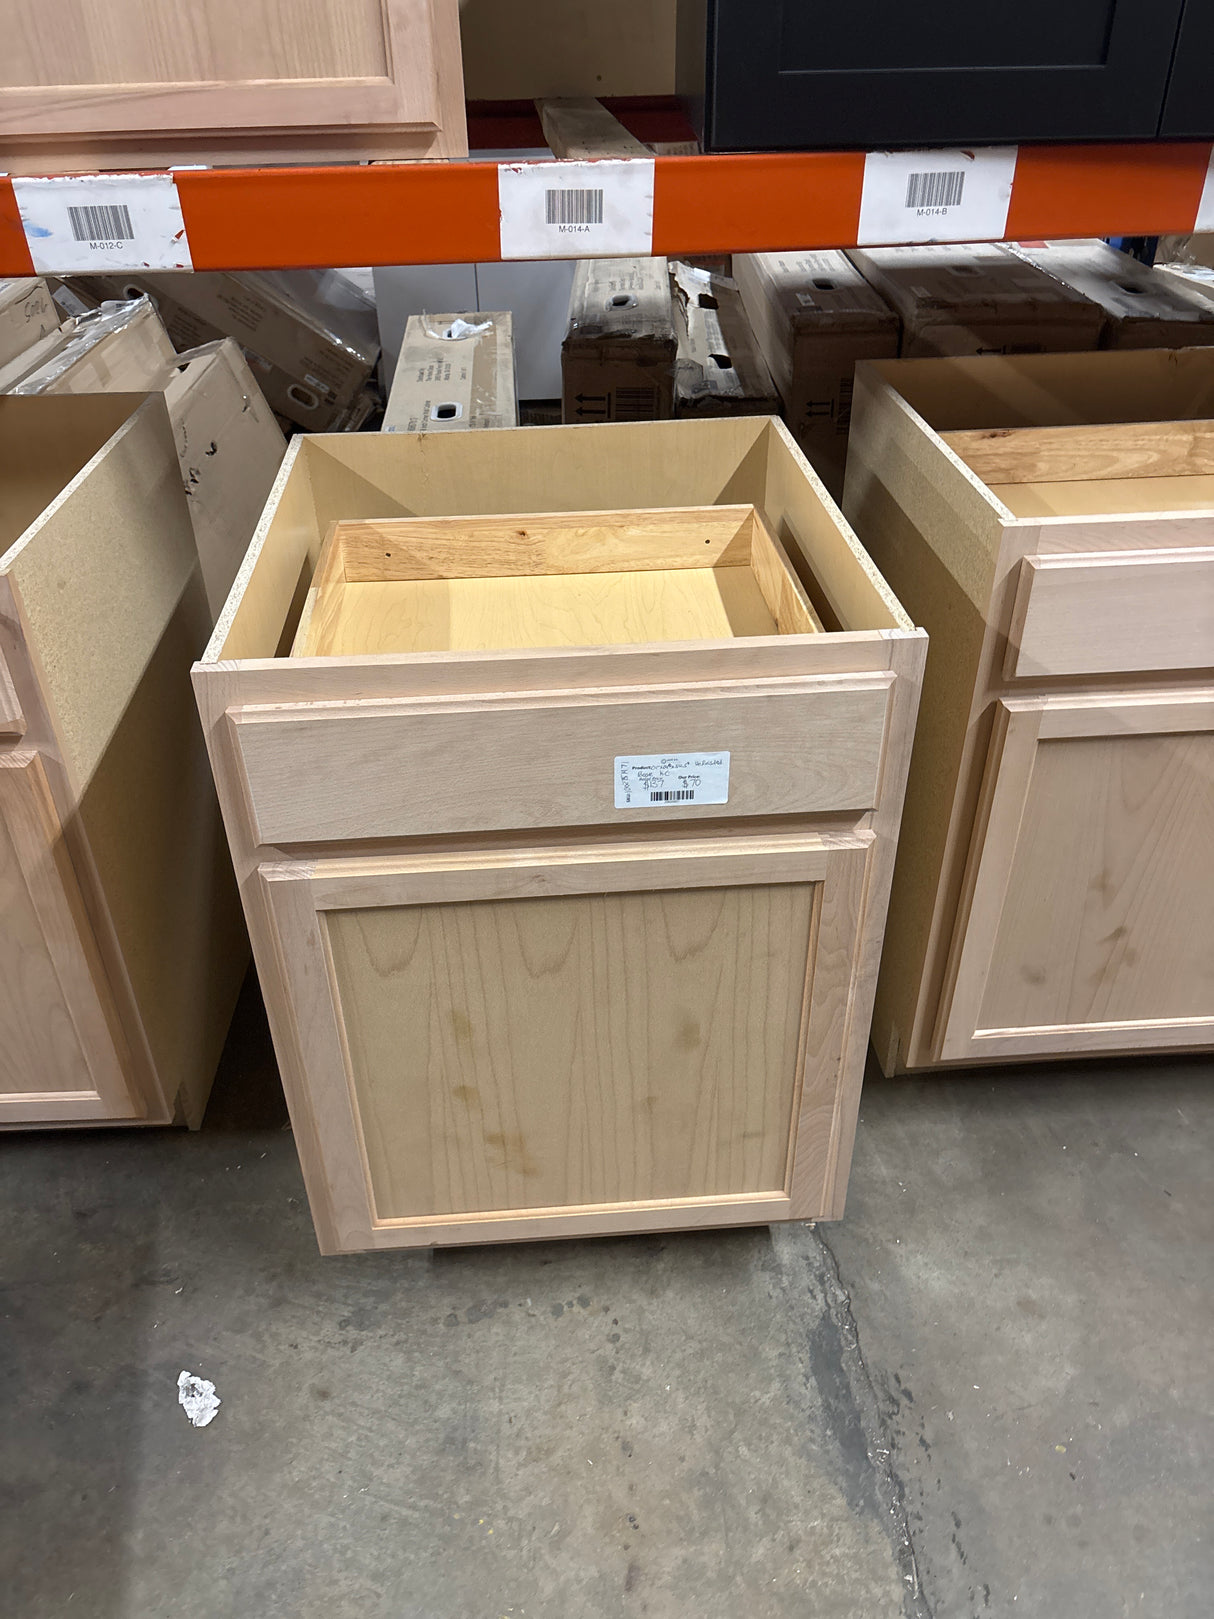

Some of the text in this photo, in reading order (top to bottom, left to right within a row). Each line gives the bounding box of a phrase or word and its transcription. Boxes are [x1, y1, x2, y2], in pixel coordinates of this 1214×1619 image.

[916, 207, 948, 217] M-014-B
[558, 225, 591, 233] M-014-A
[89, 241, 123, 250] M-012-C
